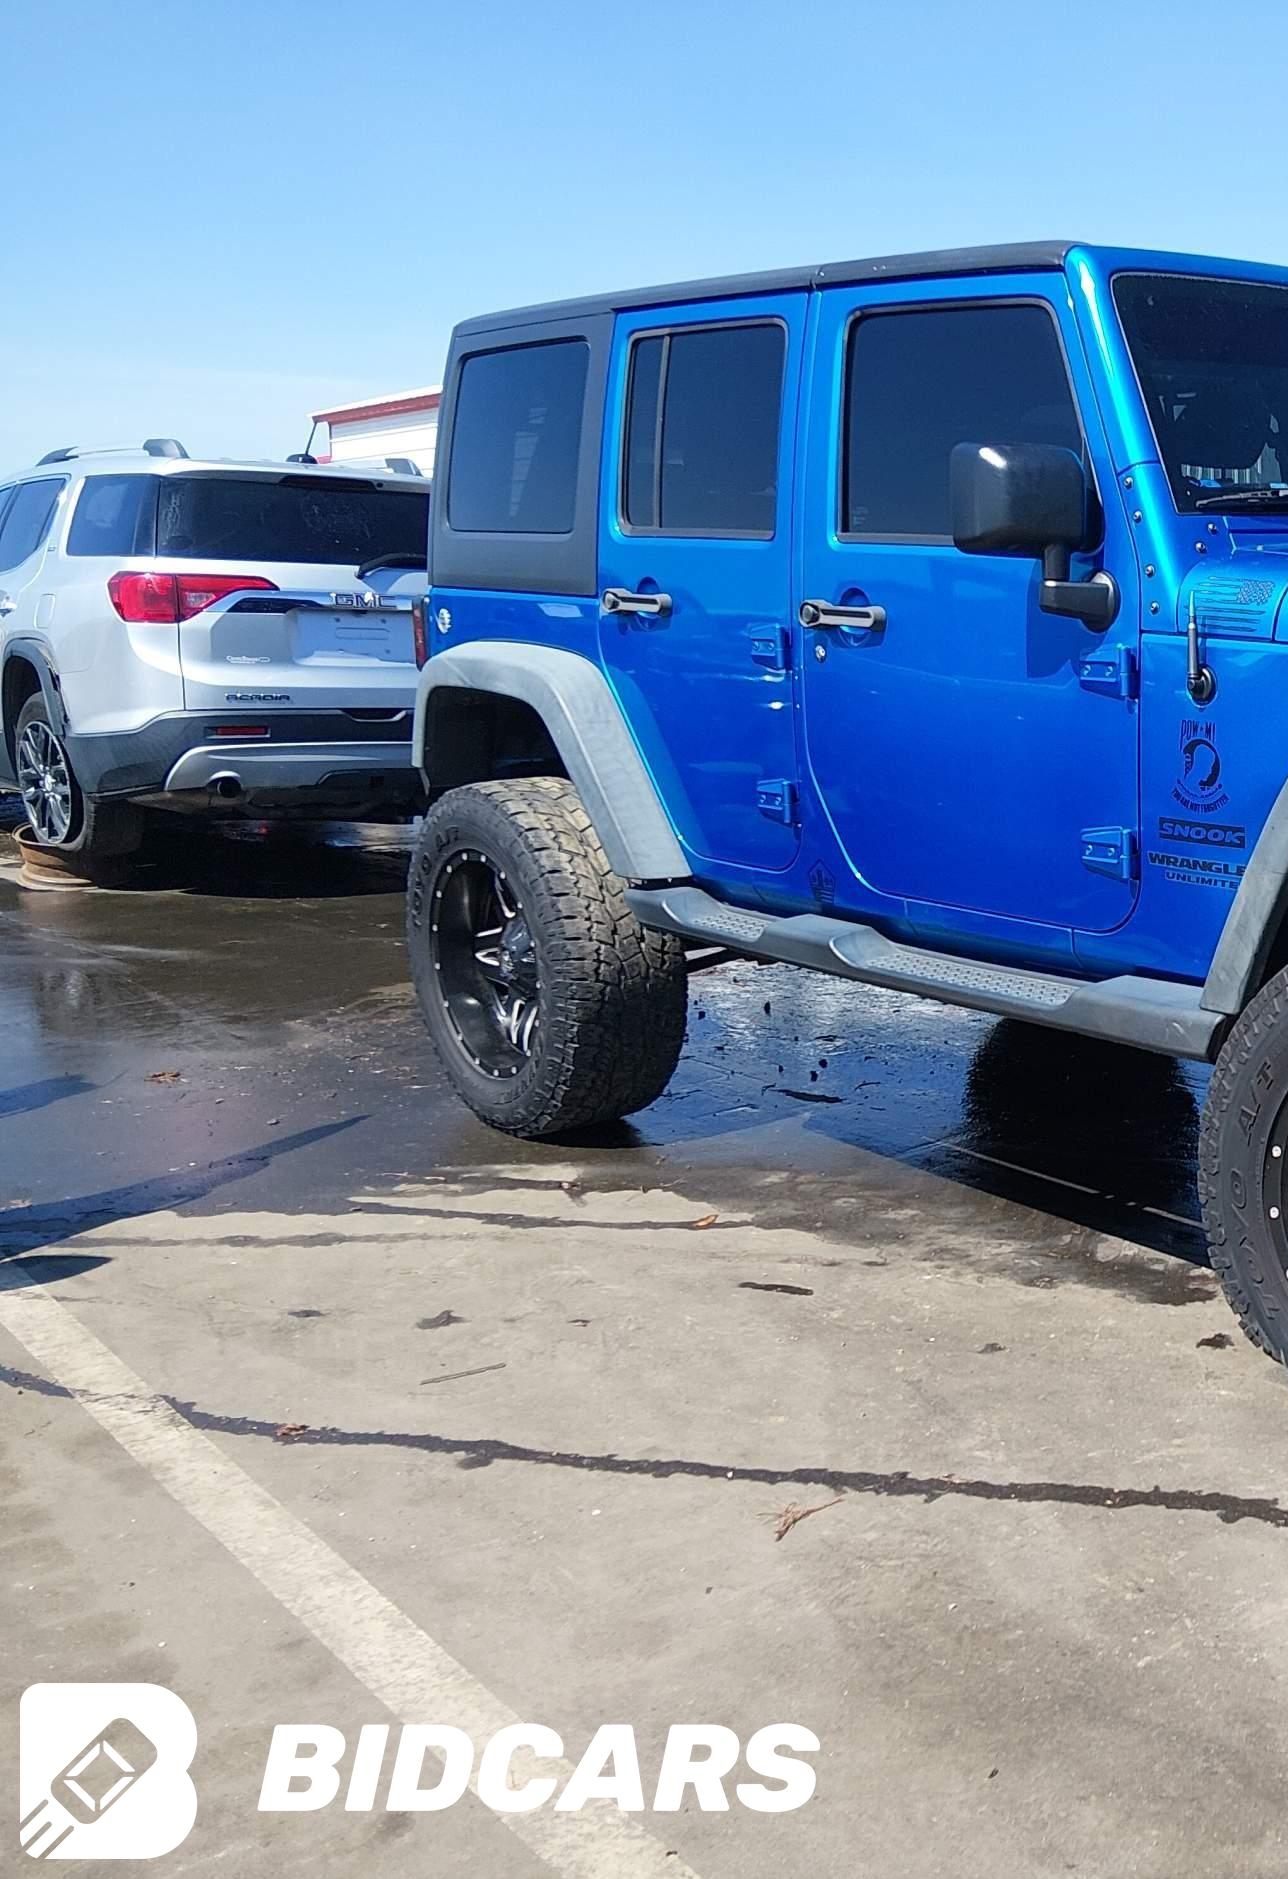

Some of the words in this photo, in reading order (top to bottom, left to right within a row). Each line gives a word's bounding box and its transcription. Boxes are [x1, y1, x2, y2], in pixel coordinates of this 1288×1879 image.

[334, 592, 398, 608] GMC
[225, 692, 291, 703] ACADIA
[1160, 821, 1245, 844] SNOOK
[1148, 852, 1247, 876] WRANGLE
[1166, 871, 1239, 889] UNLIMITE
[1237, 1056, 1275, 1147] A/T
[1229, 1167, 1282, 1322] TOYO
